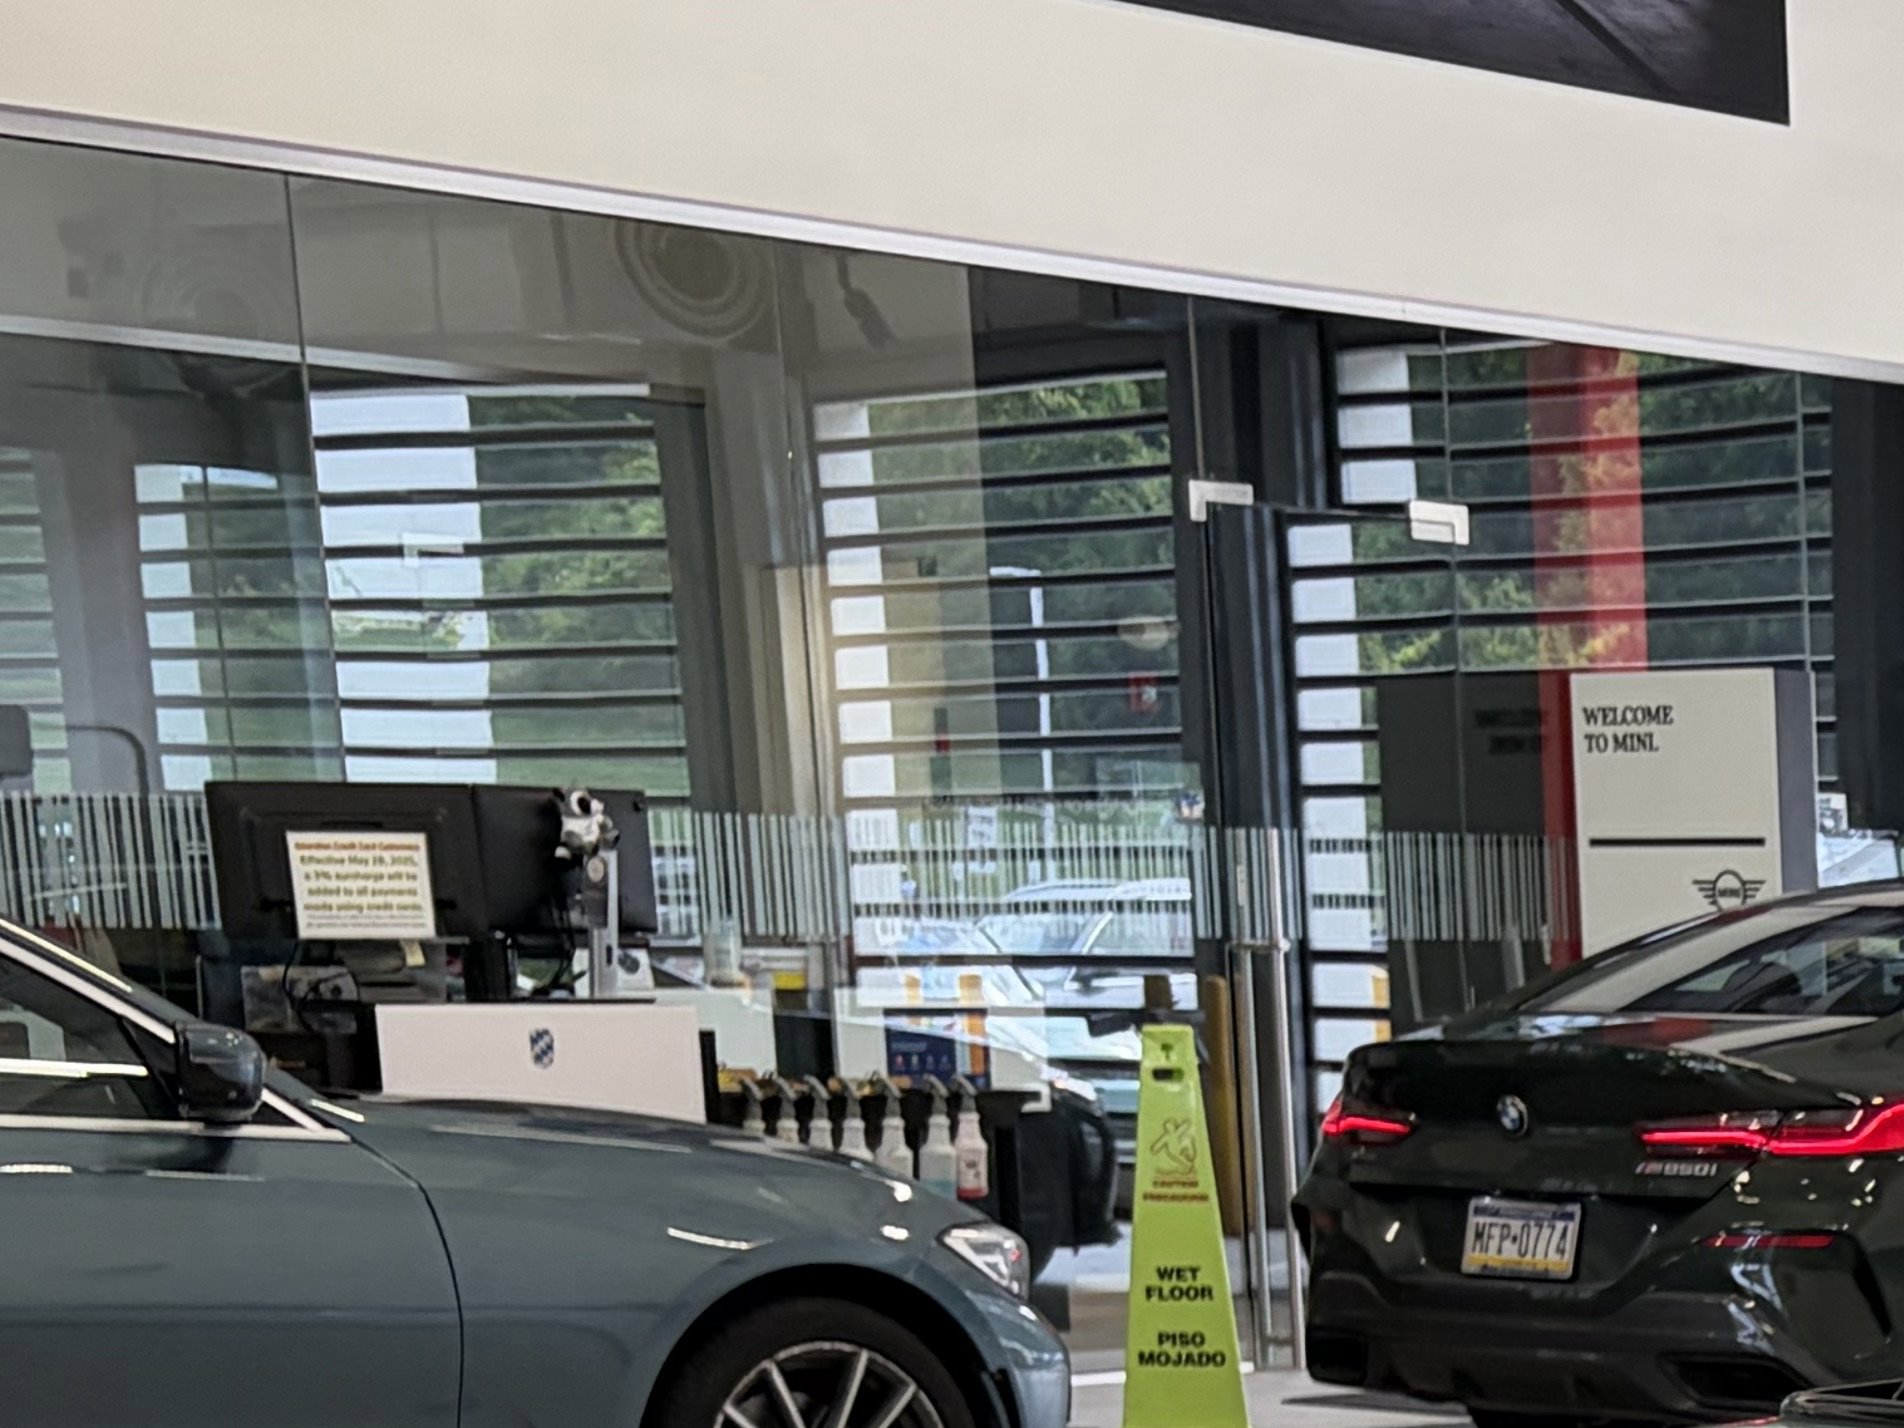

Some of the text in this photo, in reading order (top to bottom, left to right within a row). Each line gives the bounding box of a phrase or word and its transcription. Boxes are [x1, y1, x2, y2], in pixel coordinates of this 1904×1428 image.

[1581, 704, 1675, 727] WELCOME
[1583, 732, 1609, 754] TO
[1156, 1266, 1201, 1282] WET
[1145, 1285, 1214, 1302] FLOOR
[1157, 1331, 1206, 1349] PISO
[1138, 1351, 1227, 1368] MOJADO
